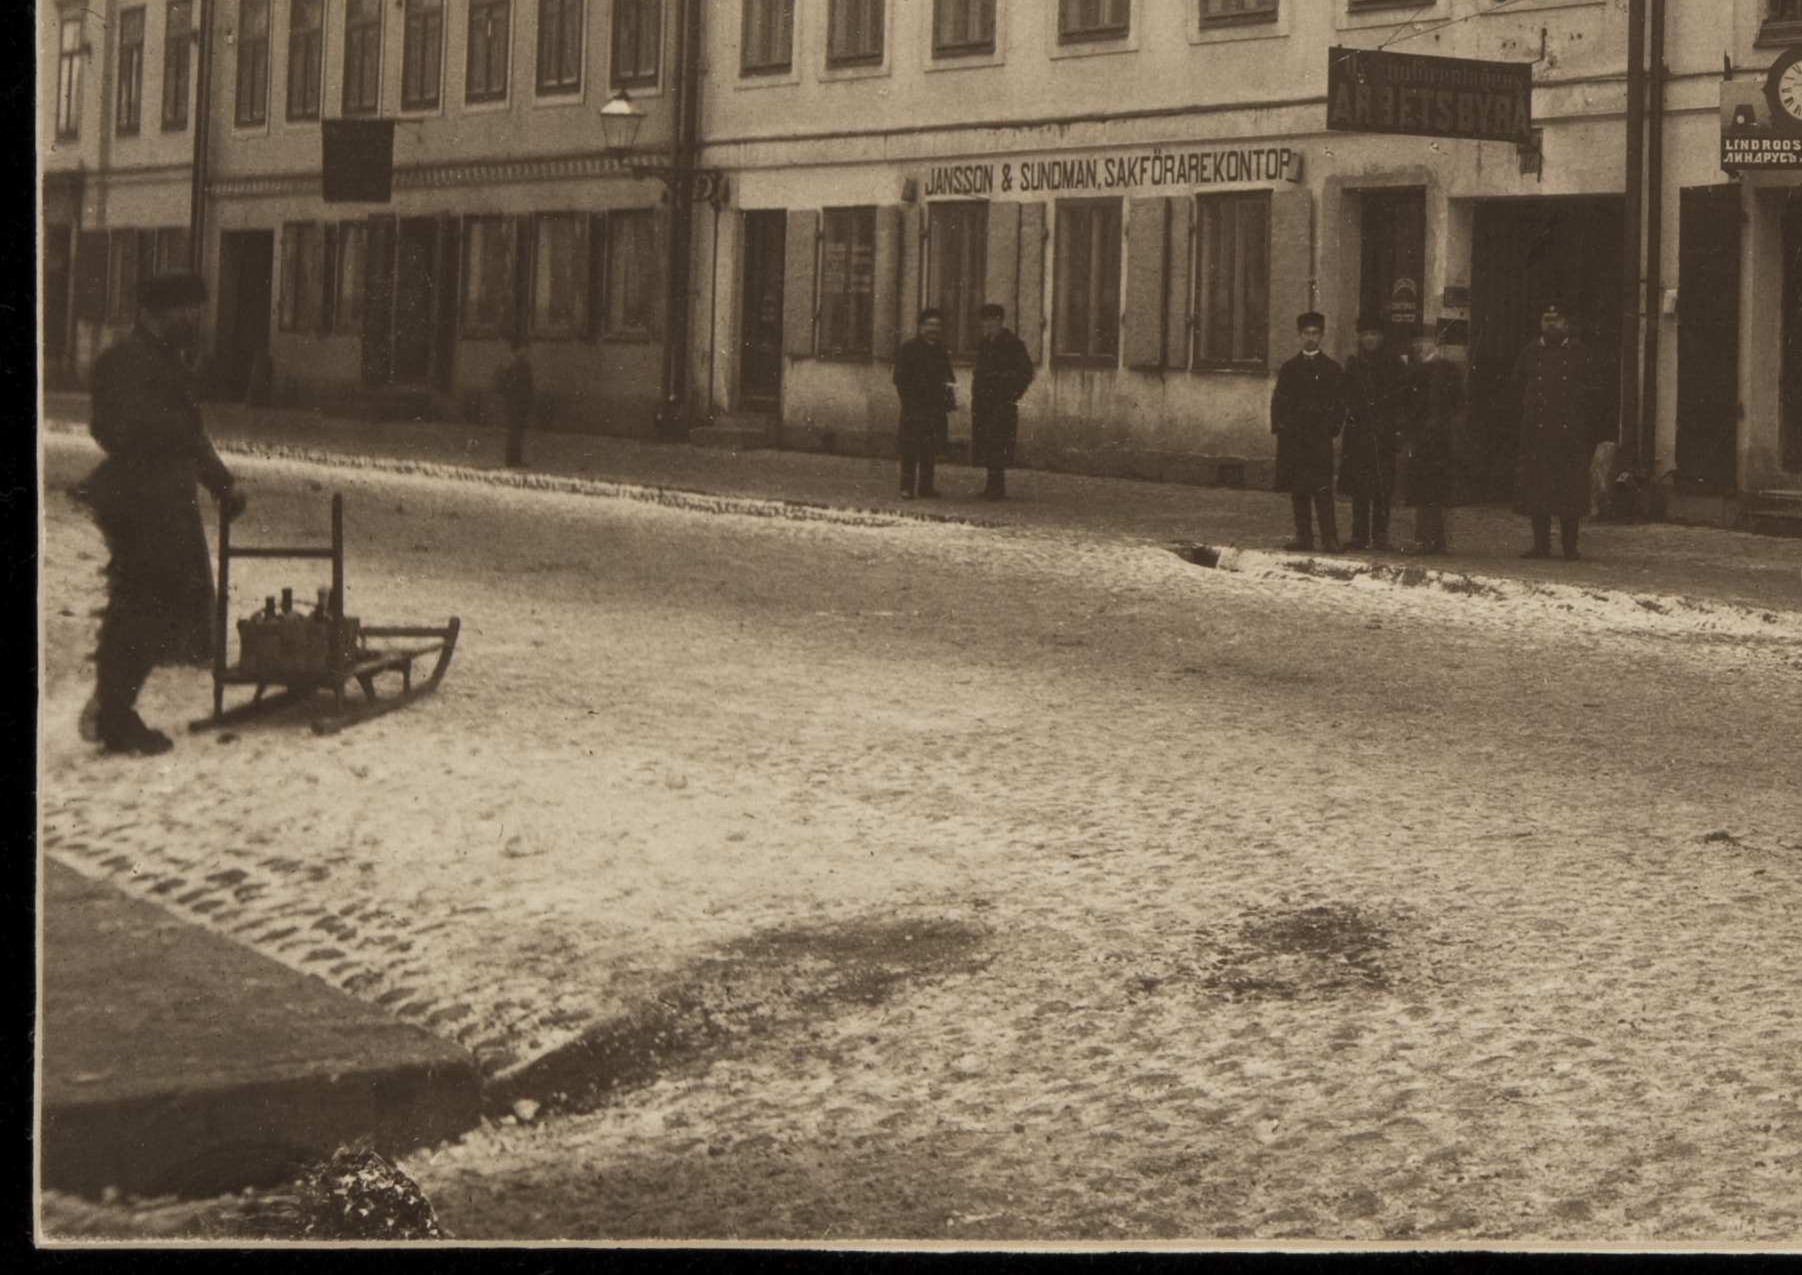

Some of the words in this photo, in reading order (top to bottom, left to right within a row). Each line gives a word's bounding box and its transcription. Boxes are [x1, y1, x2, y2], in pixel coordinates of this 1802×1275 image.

[1332, 81, 1531, 136] ARBETSBYRÅ
[1725, 139, 1801, 151] LINDROOS
[925, 164, 993, 196] JANSSON
[1001, 163, 1012, 192] &
[1020, 159, 1102, 191] SUNDMAN,
